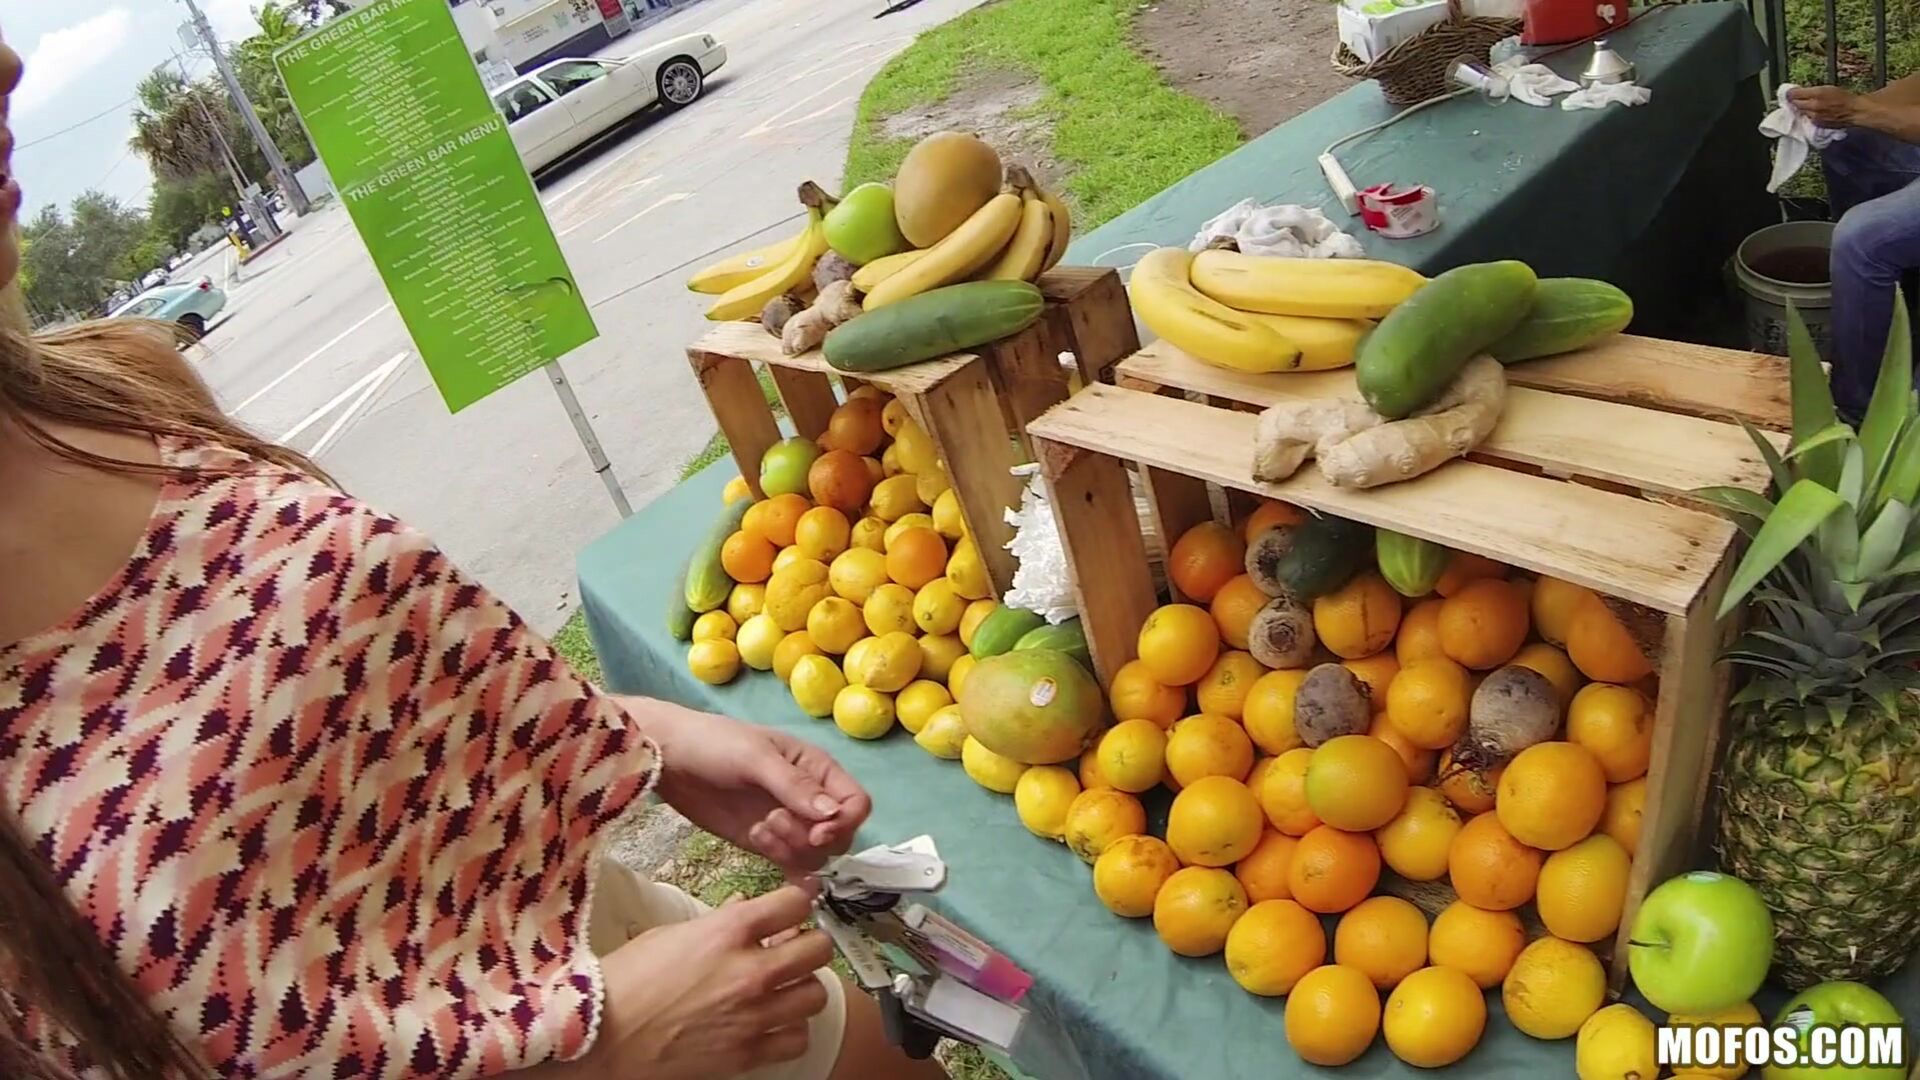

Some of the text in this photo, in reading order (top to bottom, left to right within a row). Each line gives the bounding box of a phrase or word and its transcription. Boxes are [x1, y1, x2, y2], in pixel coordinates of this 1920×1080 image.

[280, 47, 310, 67] THE
[310, 18, 359, 50] GREEN
[359, 1, 390, 24] BAR
[348, 120, 500, 202] THE GREEN BAR MENU
